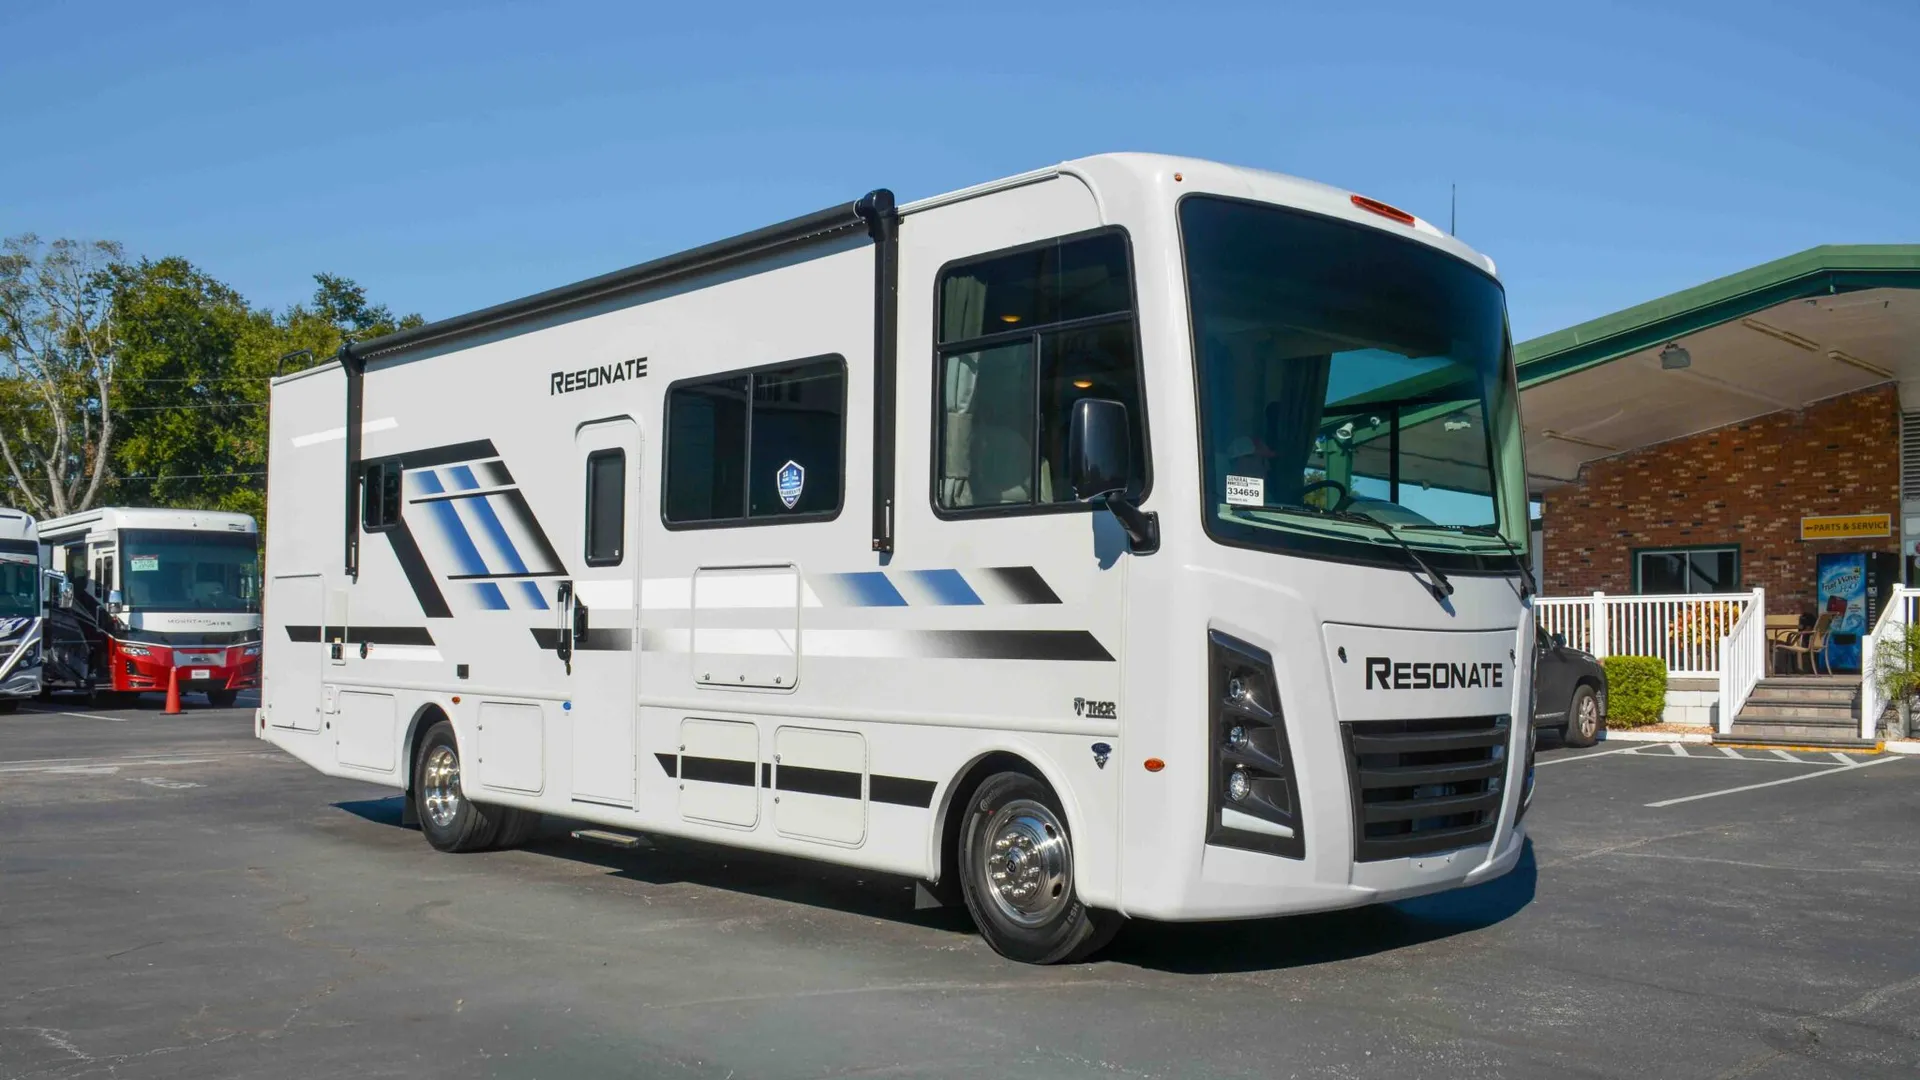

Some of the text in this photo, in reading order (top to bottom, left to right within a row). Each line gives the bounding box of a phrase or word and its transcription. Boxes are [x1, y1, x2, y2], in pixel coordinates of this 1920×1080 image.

[551, 357, 648, 396] RESONATE
[1228, 487, 1260, 498] 334659
[1814, 520, 1888, 533] PARTS & SERVICE
[1366, 657, 1503, 690] RESONATE
[1086, 701, 1117, 715] THOR
